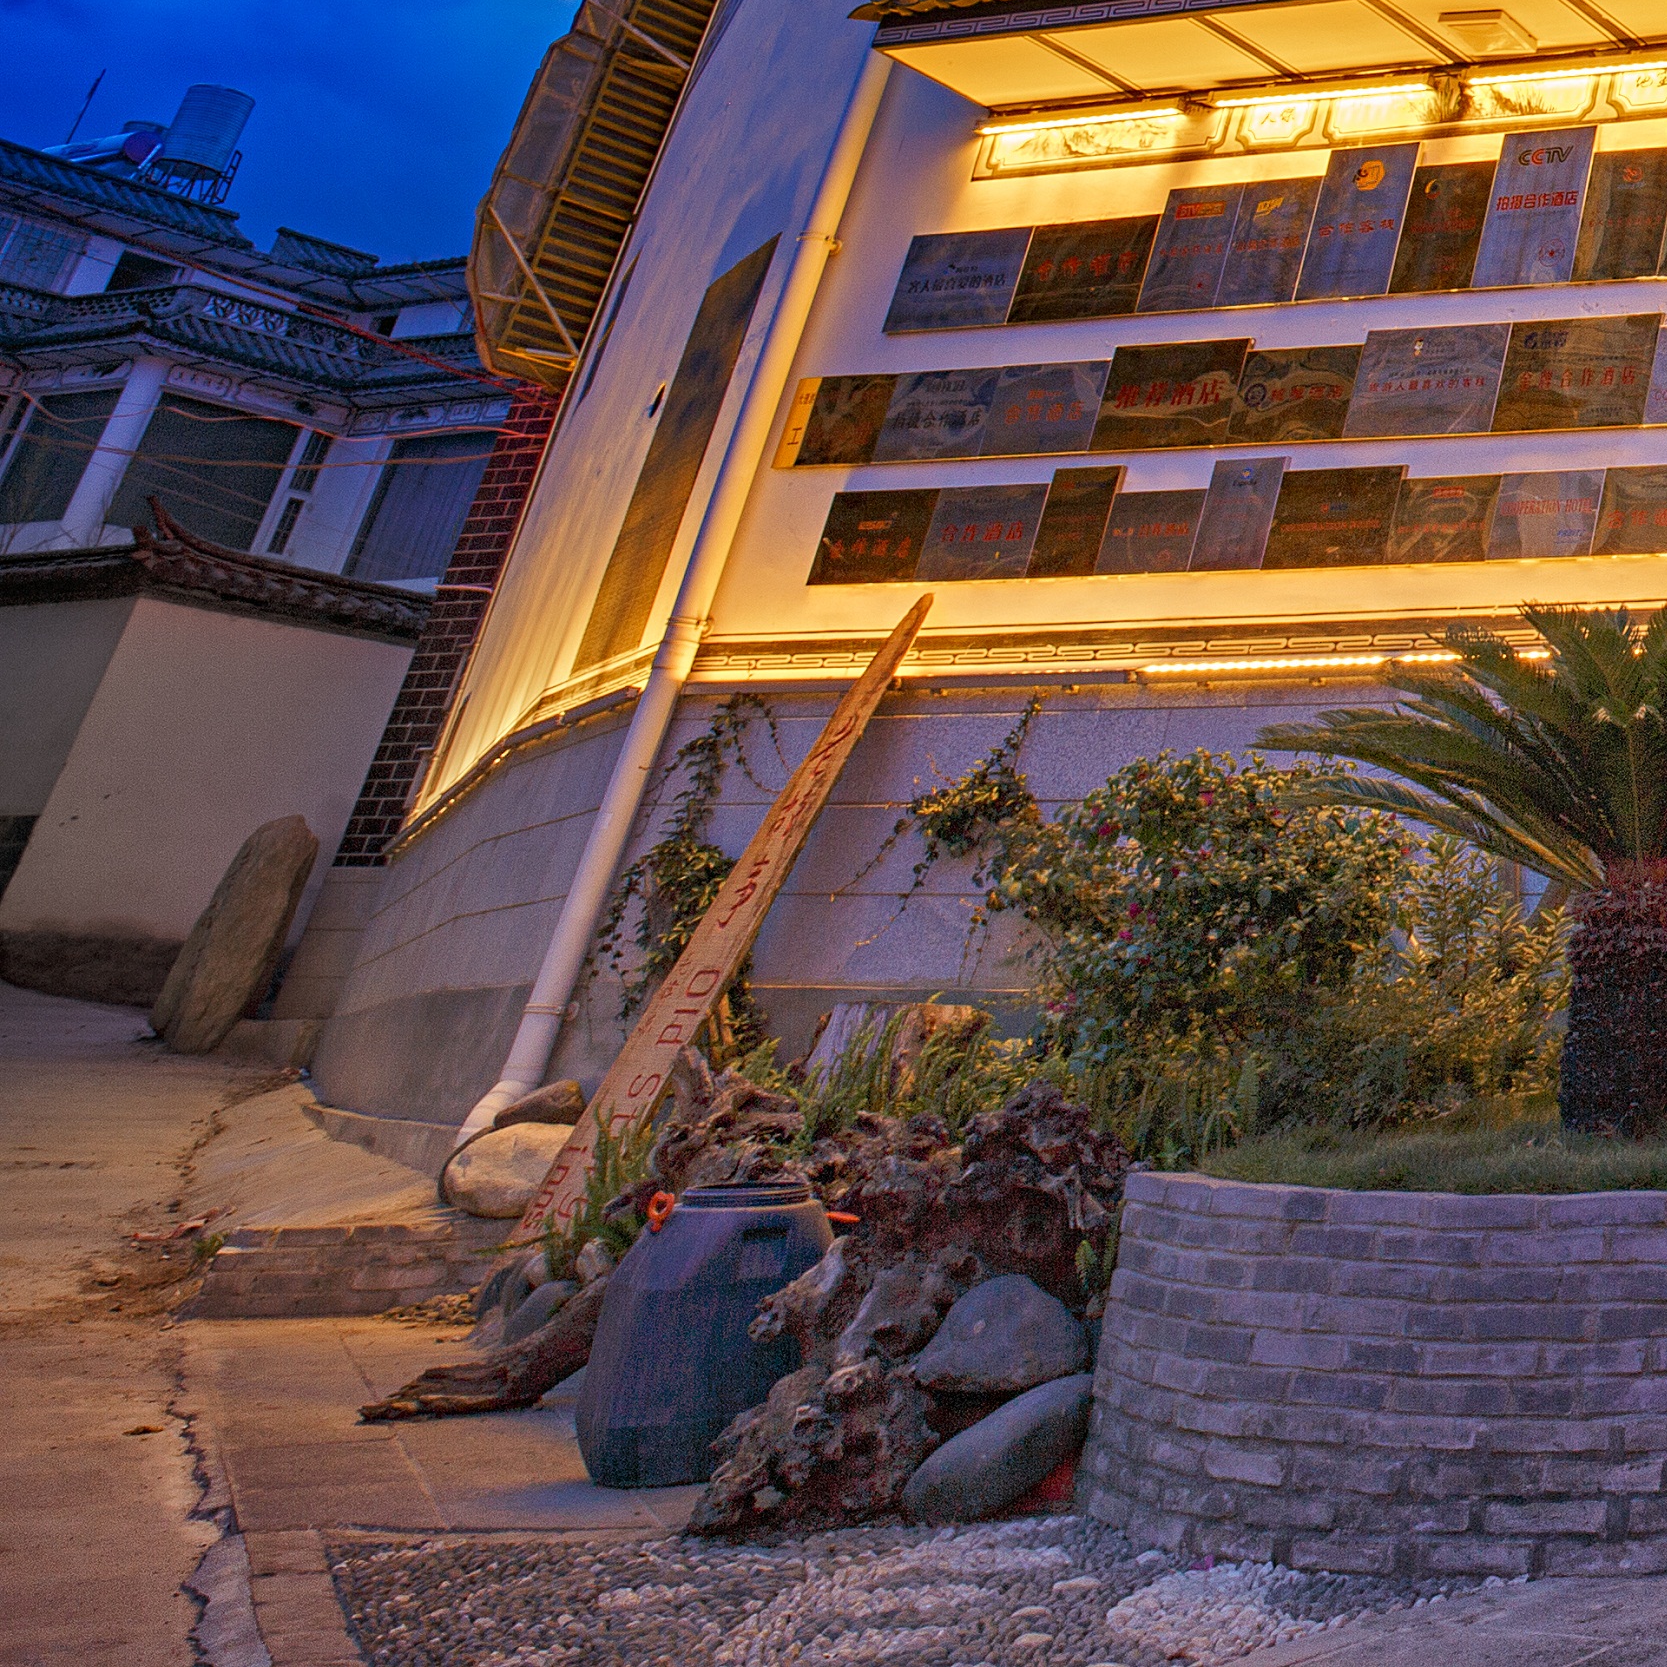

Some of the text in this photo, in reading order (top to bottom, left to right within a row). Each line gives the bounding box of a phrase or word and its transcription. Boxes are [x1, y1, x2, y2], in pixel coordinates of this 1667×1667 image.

[1518, 146, 1573, 166] CCTV
[1496, 190, 1579, 211] 拍摄合作酒店
